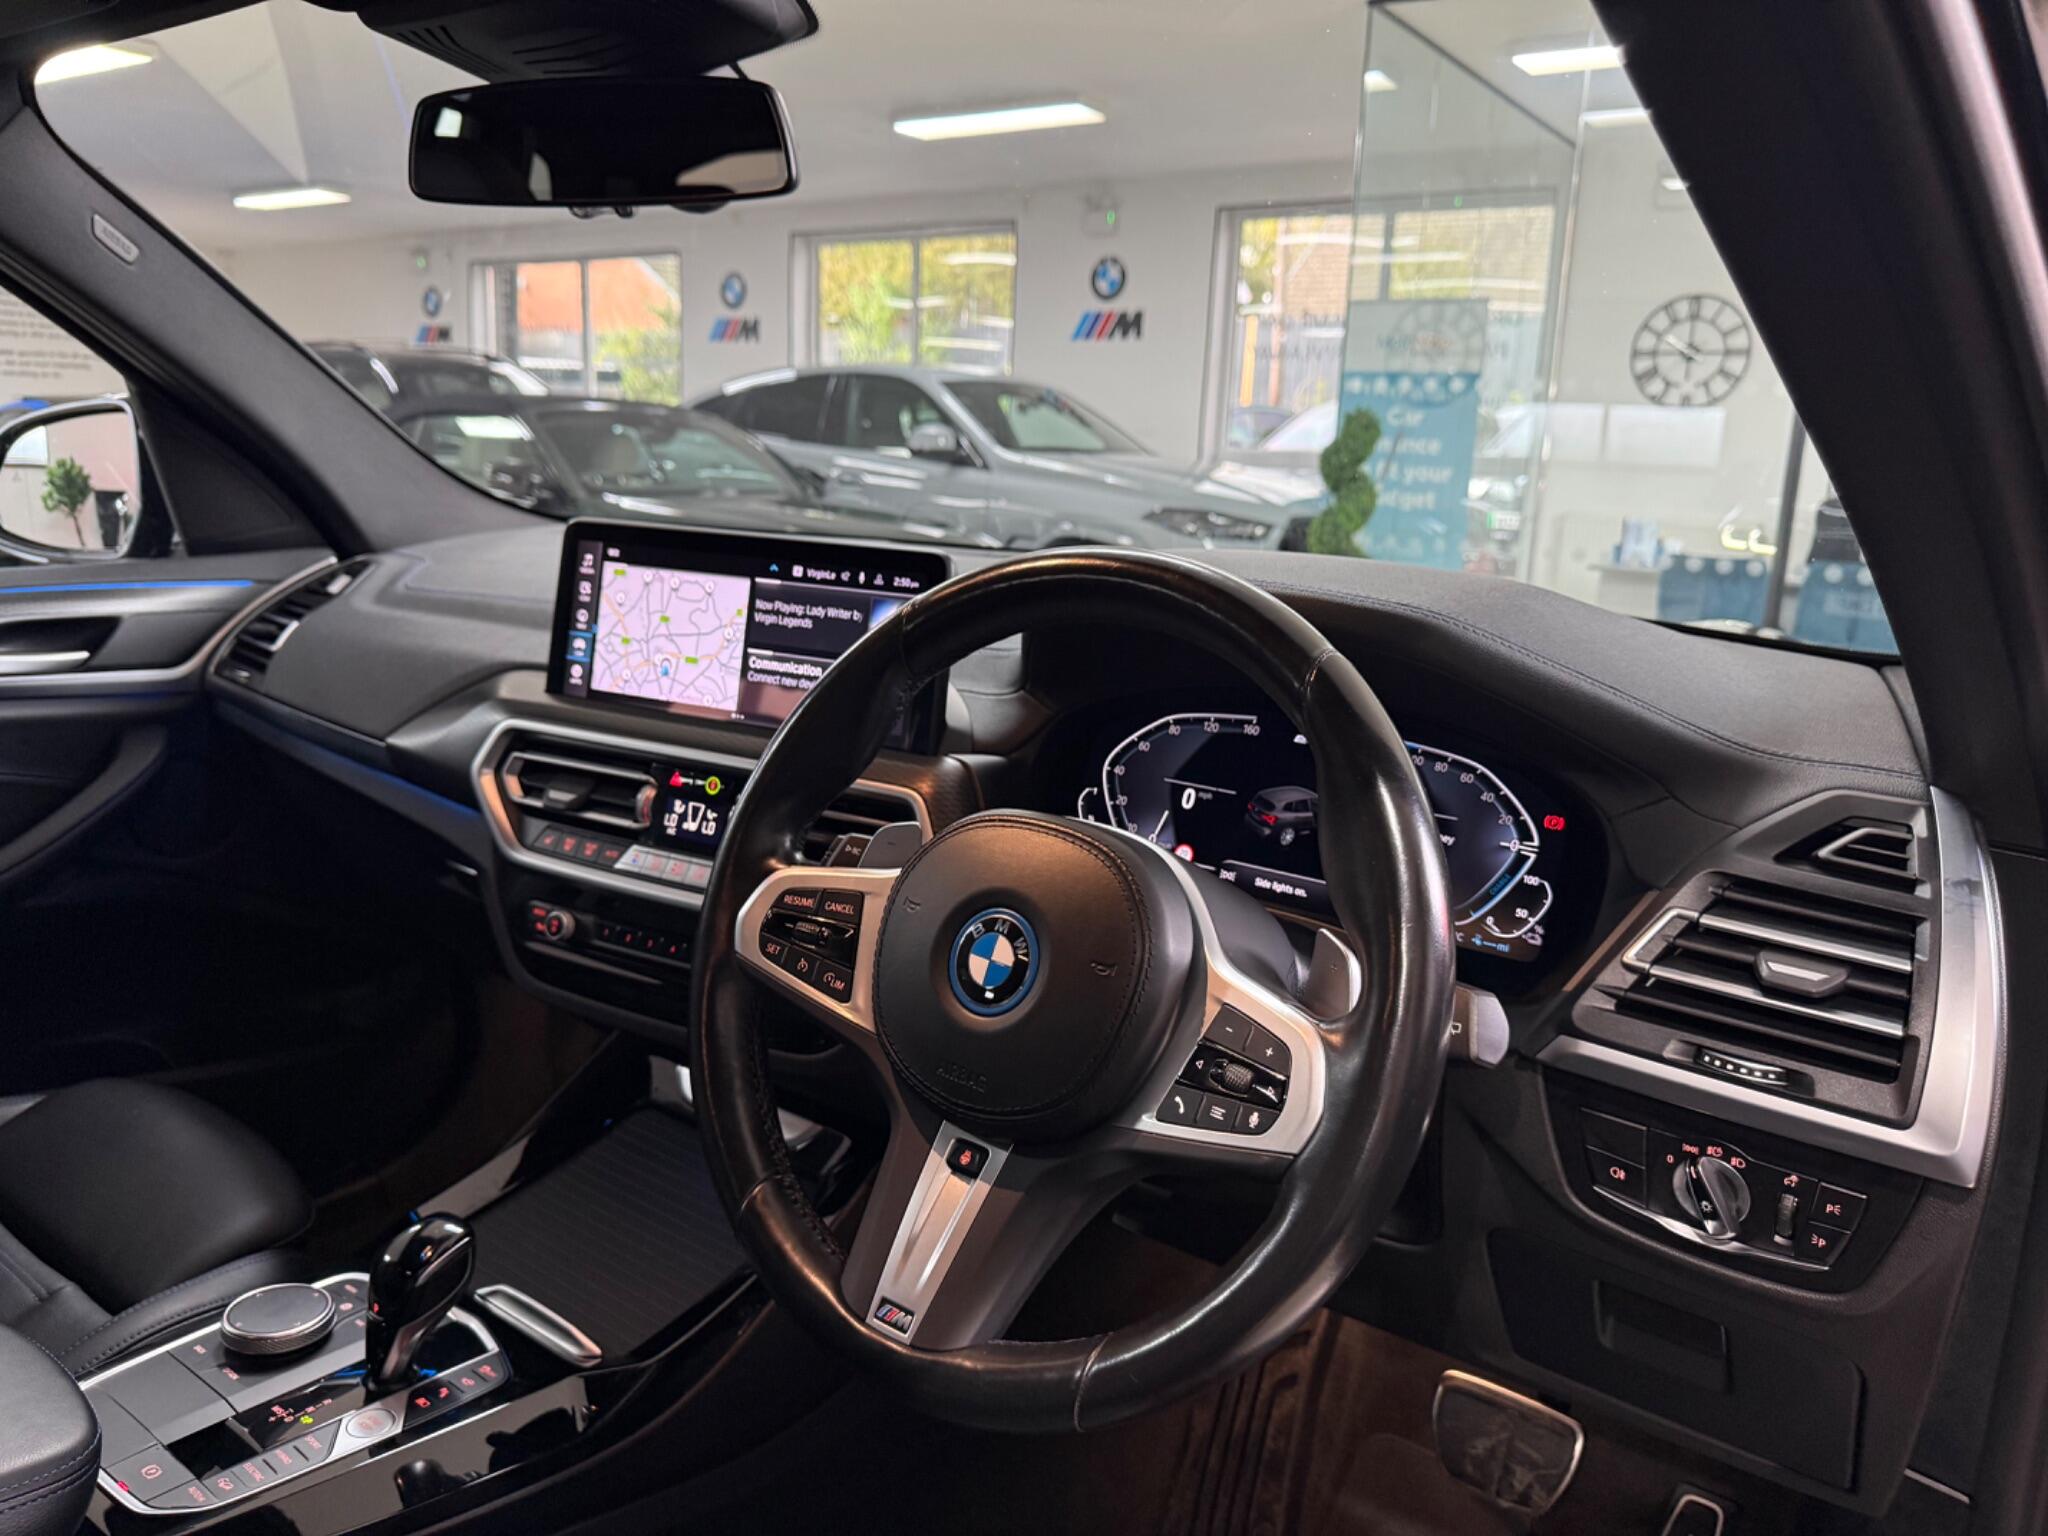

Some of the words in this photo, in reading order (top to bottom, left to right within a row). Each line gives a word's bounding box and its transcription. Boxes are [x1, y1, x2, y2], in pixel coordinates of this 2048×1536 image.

[755, 598, 773, 611] Now
[806, 604, 827, 619] Lady
[827, 606, 853, 620] Writer
[754, 611, 778, 626] Virgin
[778, 614, 813, 629] Legends
[749, 656, 823, 677] Communication
[747, 670, 780, 685] Connect
[781, 676, 798, 688] new
[1168, 724, 1181, 736] 80
[1203, 721, 1220, 734] 120
[1243, 724, 1260, 736] 160
[1138, 740, 1151, 752] 60
[1113, 764, 1126, 776] 40
[1434, 761, 1449, 774] 80
[1459, 772, 1475, 785] 60
[1116, 794, 1128, 806] 20
[1181, 787, 1196, 810] 0
[1480, 791, 1495, 803] 40
[1498, 814, 1514, 826] 20
[1254, 876, 1272, 890] Side
[1272, 880, 1294, 894] lights
[1523, 875, 1539, 887] 100
[783, 894, 816, 909] RESUME
[824, 900, 855, 915] CANCEL
[1515, 907, 1530, 919] 50
[971, 917, 1030, 963] BMW
[765, 942, 782, 955] SET
